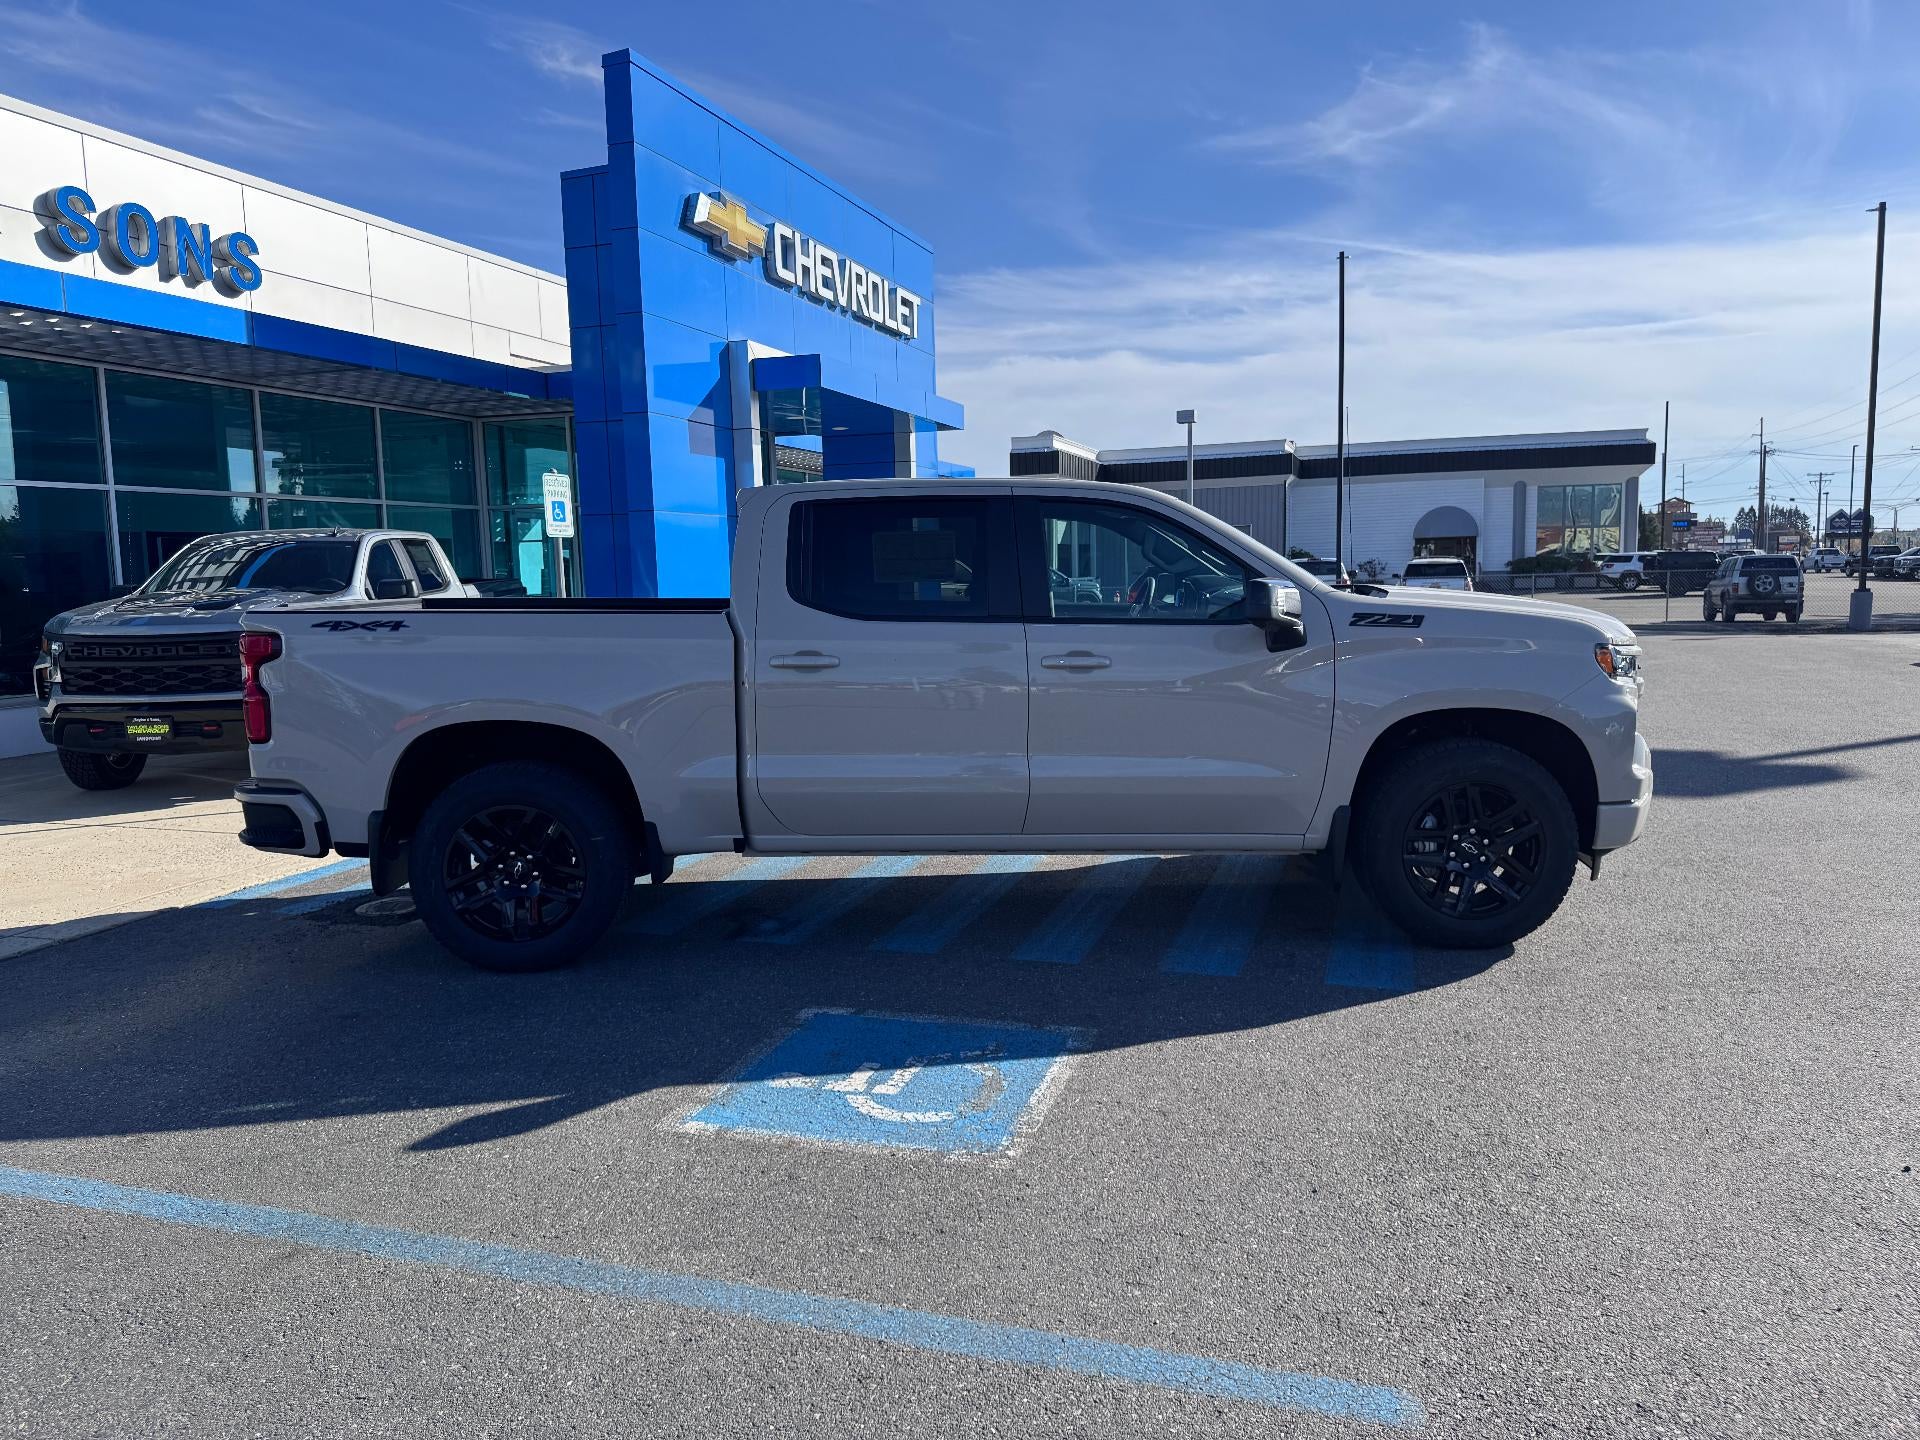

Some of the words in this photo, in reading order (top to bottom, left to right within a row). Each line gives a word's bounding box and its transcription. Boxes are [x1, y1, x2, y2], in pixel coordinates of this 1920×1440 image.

[46, 185, 263, 295] SONS
[768, 222, 921, 340] CHEVROLET
[544, 478, 568, 488] RESERVED
[544, 489, 568, 499] PARKING
[1349, 612, 1425, 628] Z71
